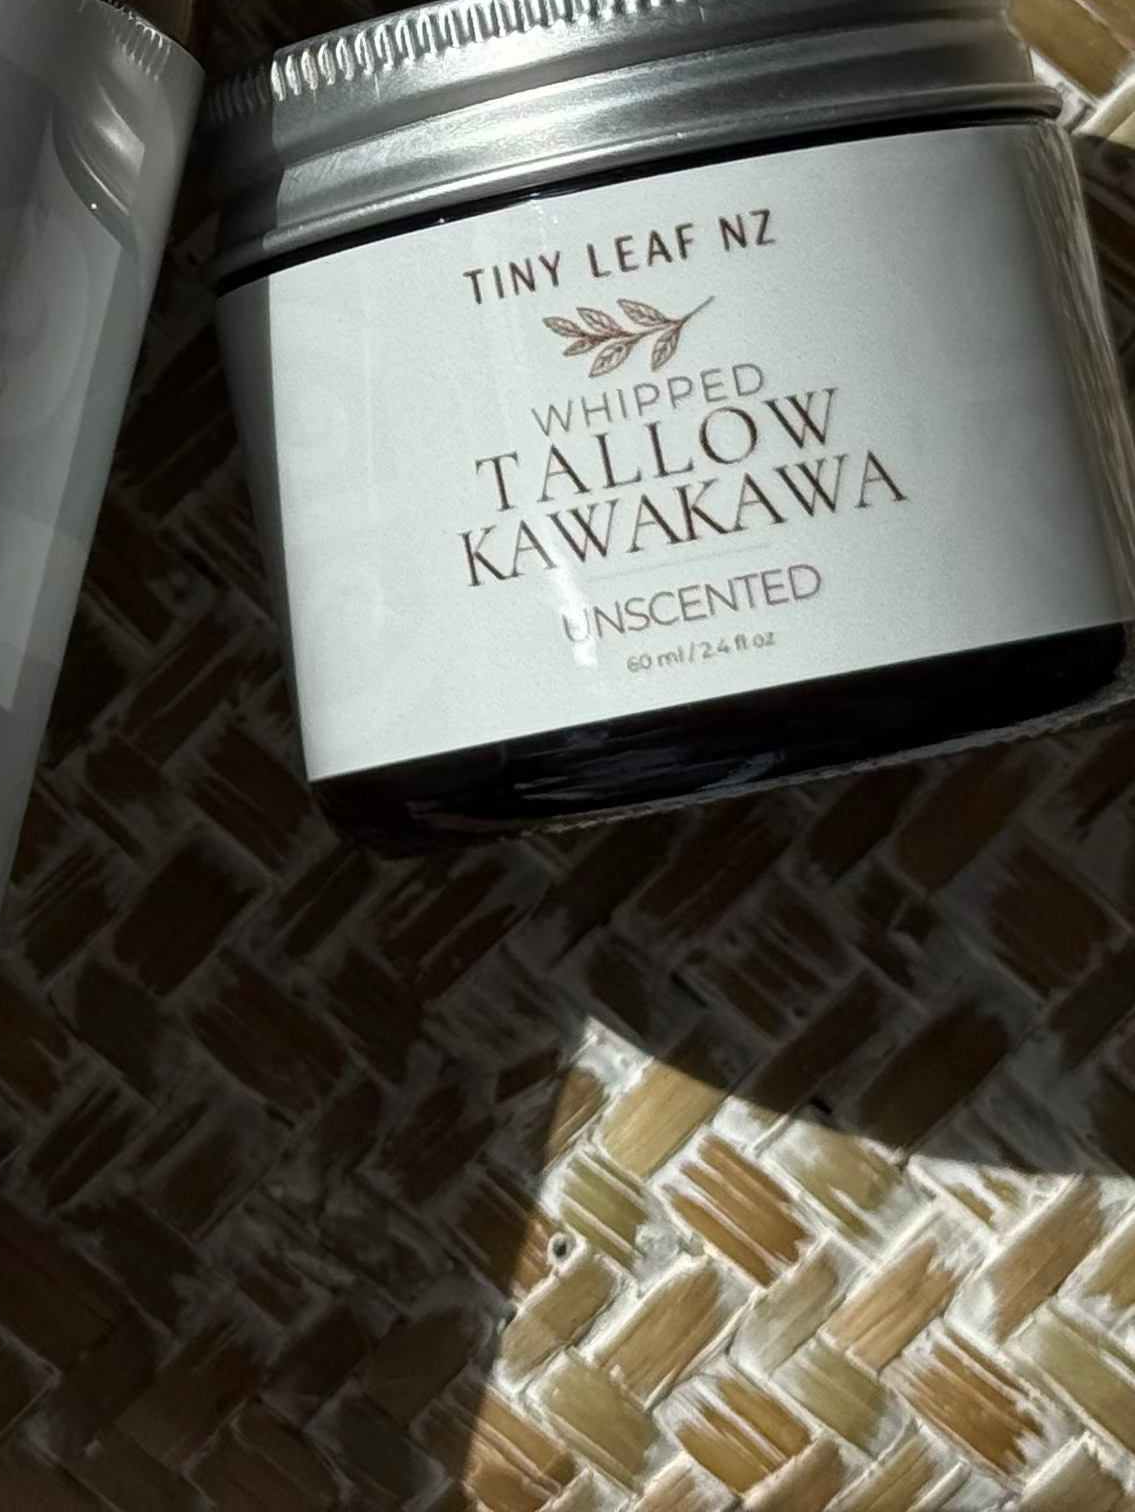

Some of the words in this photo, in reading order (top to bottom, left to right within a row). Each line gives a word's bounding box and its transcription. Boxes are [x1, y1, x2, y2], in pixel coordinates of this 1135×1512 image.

[463, 250, 562, 306] TINY
[586, 222, 695, 279] LEAF
[718, 208, 777, 253] NZ
[530, 362, 766, 437] WHIPPED
[474, 387, 840, 514] TALLOW
[456, 449, 910, 588] KAWAKAWA
[561, 563, 823, 643] UNSCENTED
